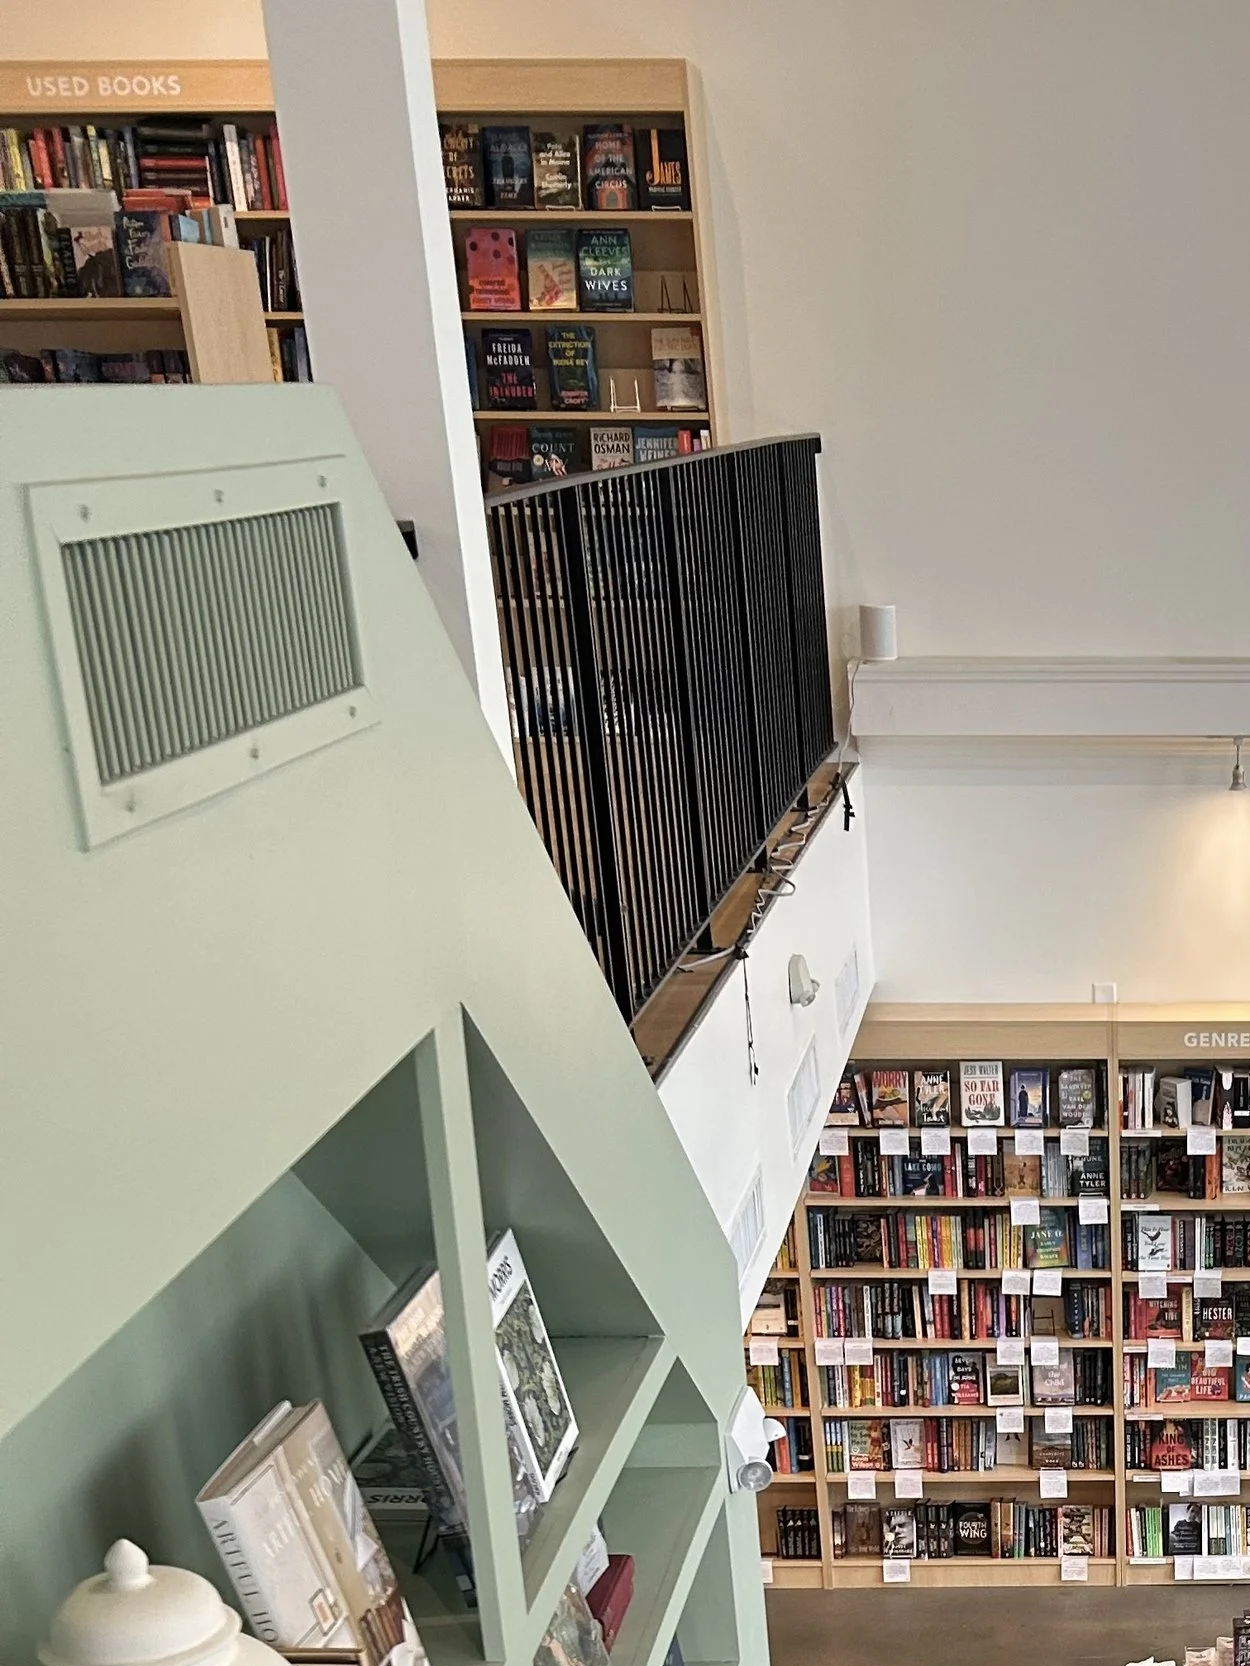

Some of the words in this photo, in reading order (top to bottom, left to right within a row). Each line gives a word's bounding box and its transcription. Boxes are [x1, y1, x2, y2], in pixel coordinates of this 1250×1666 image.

[25, 76, 89, 97] USED
[97, 75, 182, 97] BOOKS
[590, 236, 618, 246] ANN
[581, 246, 629, 257] CLEEVES
[590, 267, 621, 277] DARK
[584, 280, 628, 292] WIVES
[492, 343, 523, 355] FREIDA
[486, 355, 531, 367] McFADDEN
[593, 432, 631, 443] RICHARD
[594, 444, 631, 455] OSMAN
[1183, 1031, 1250, 1048] GENRE
[872, 1071, 909, 1089] WORRY
[921, 1075, 945, 1085] ANNE
[964, 1081, 979, 1093] SO
[980, 1080, 1000, 1093] FAR
[968, 1093, 996, 1106] GONE
[1080, 1172, 1105, 1181] ANNE
[1079, 1180, 1106, 1188] TYLER
[1202, 1307, 1233, 1320] HESTER
[1196, 1385, 1213, 1395] LIFE
[1159, 1432, 1185, 1445] KING
[1155, 1453, 1190, 1466] ASHES
[959, 1520, 988, 1530] FOURTH
[959, 1528, 988, 1539] WING
